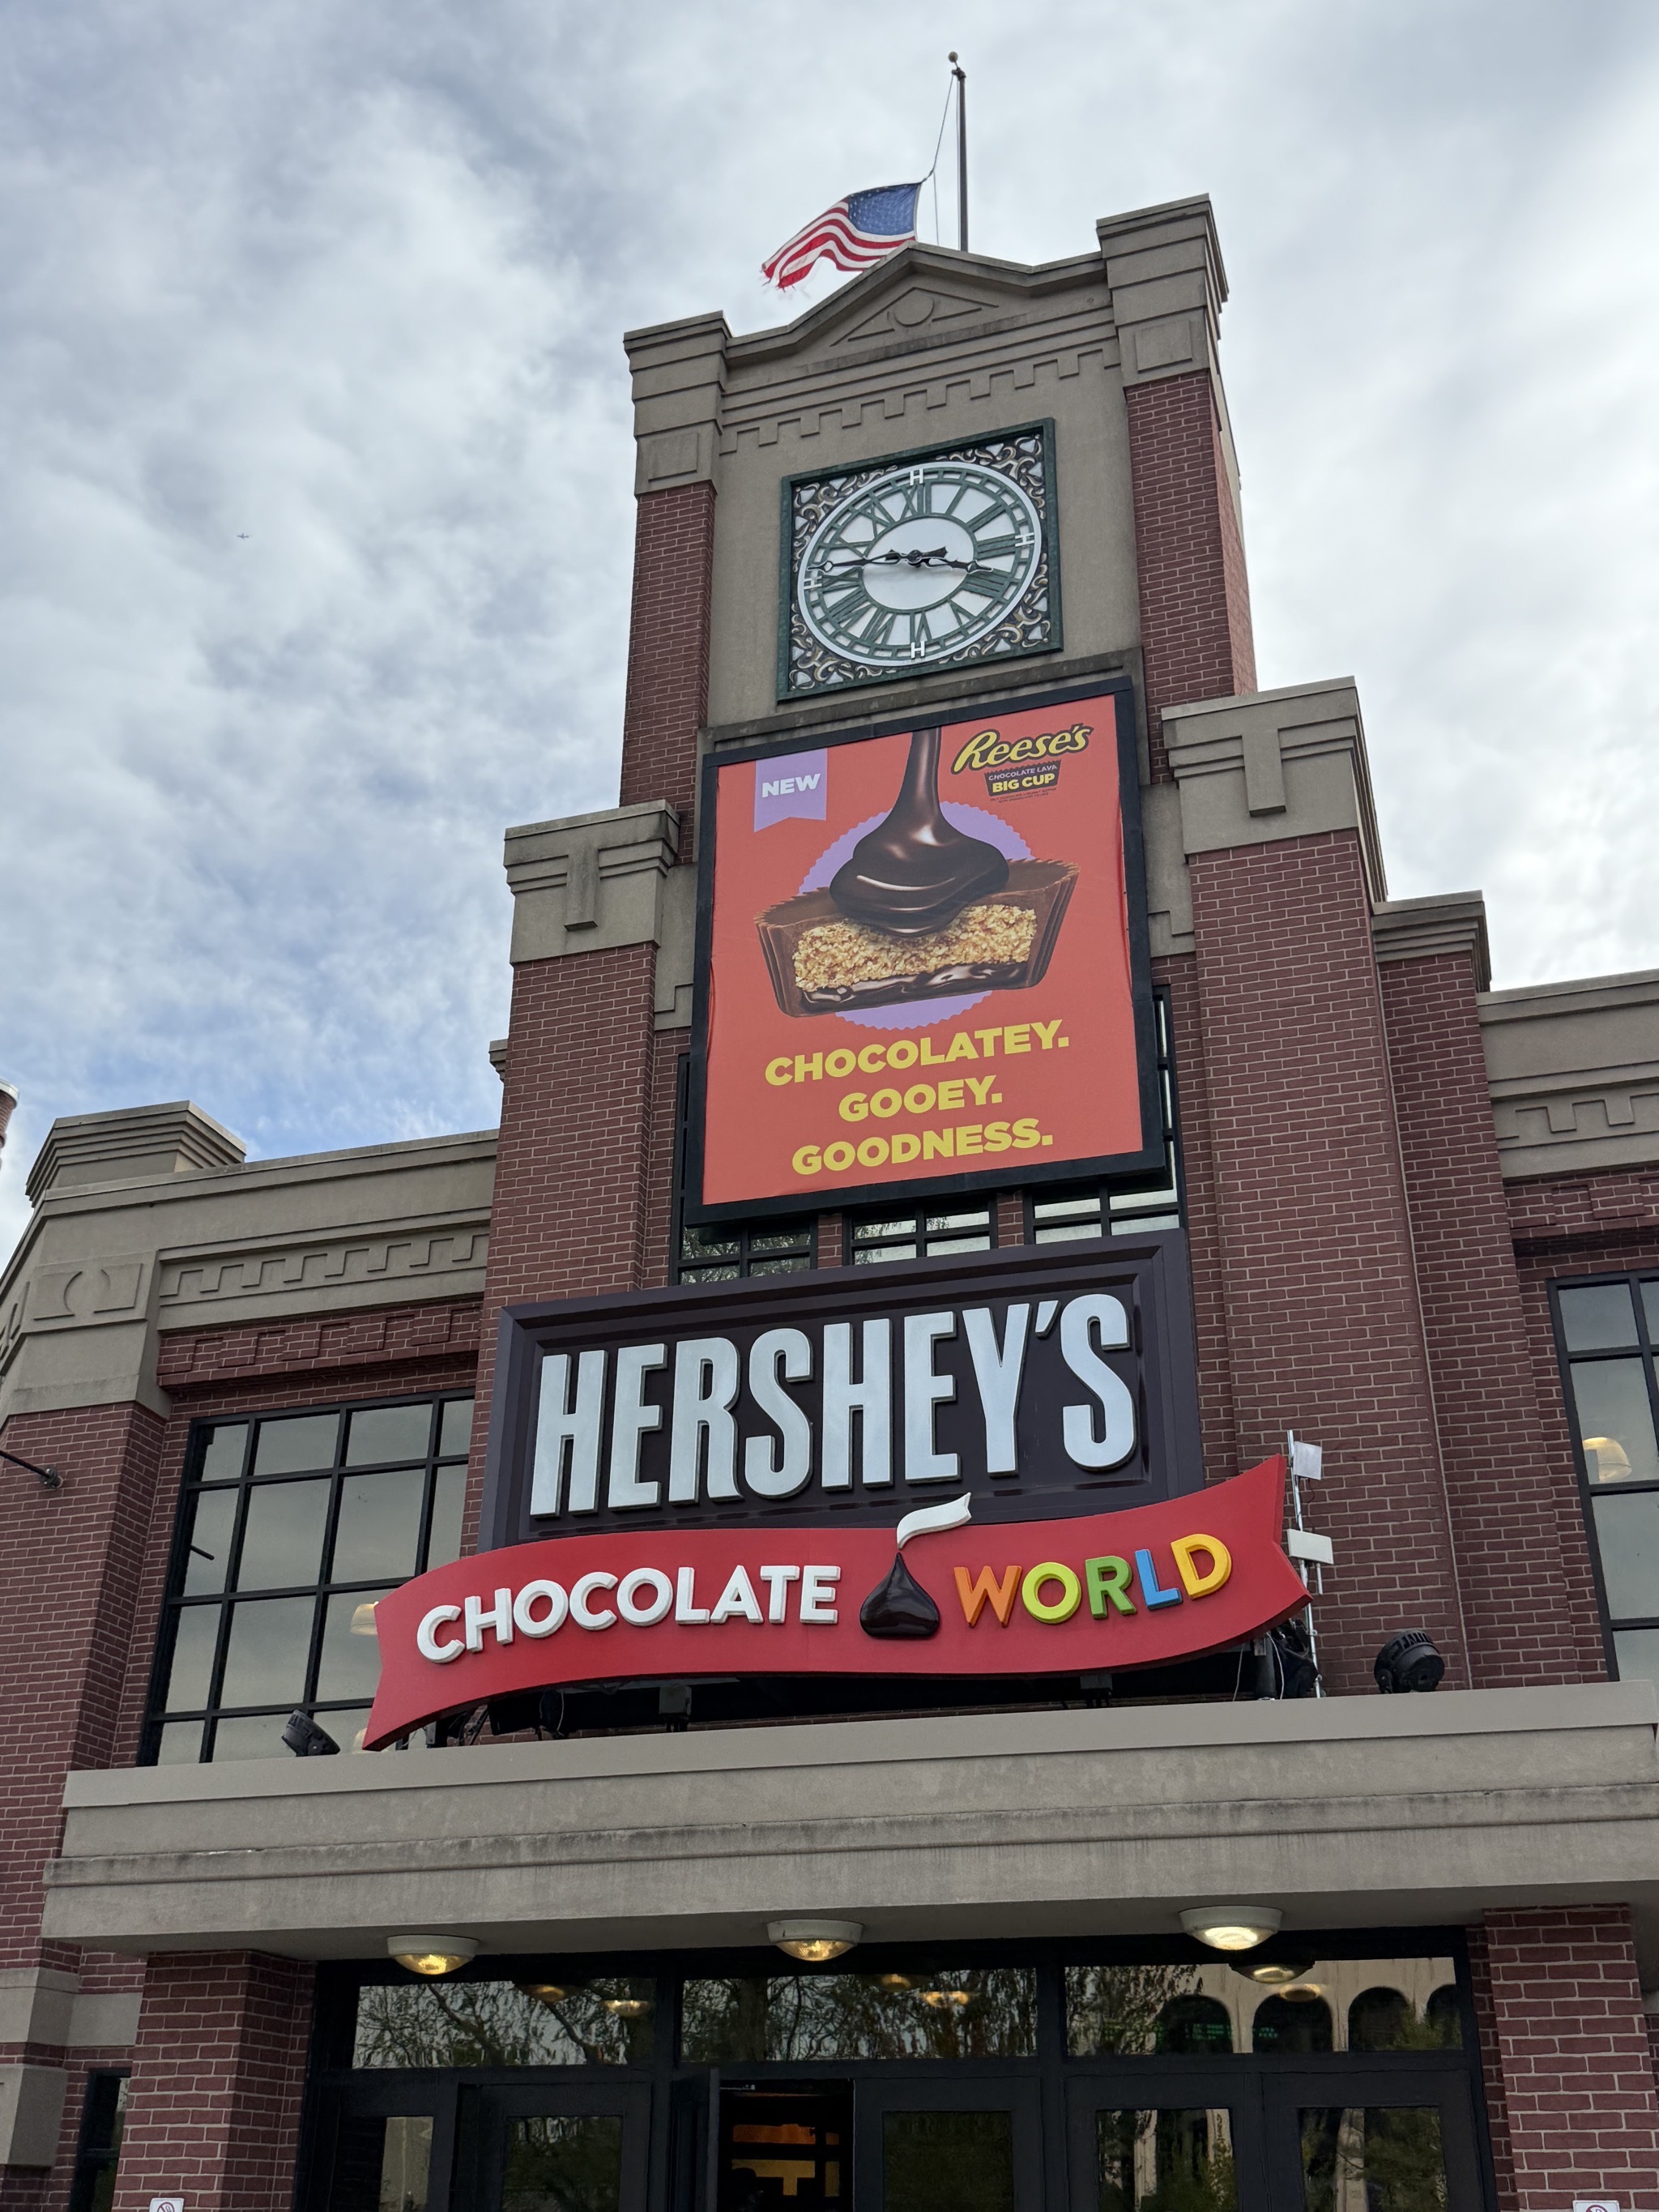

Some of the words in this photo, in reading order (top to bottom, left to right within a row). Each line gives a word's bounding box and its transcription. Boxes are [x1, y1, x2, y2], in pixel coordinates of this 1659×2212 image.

[910, 468, 924, 486] H
[901, 483, 932, 521] XII
[966, 499, 1007, 532] II
[975, 532, 1017, 561] III
[1014, 532, 1035, 548] H
[803, 574, 823, 591] H
[910, 609, 933, 644] VI
[910, 639, 926, 660] H
[952, 724, 1094, 774] Reese's
[762, 773, 821, 798] NEW
[988, 768, 1036, 781] CHOCOLATE
[1037, 764, 1058, 773] LAVA
[992, 779, 1020, 793] BIG
[1021, 773, 1056, 788] CUP
[765, 1019, 1069, 1086] CHOCOLATEY.
[838, 1074, 1003, 1122] GOOEY.
[791, 1118, 1053, 1175] GOODNESS.
[529, 1293, 1137, 1519] HERSHEY'S
[416, 1565, 842, 1664] CHOCOLATE
[953, 1533, 1232, 1628] WORLD
